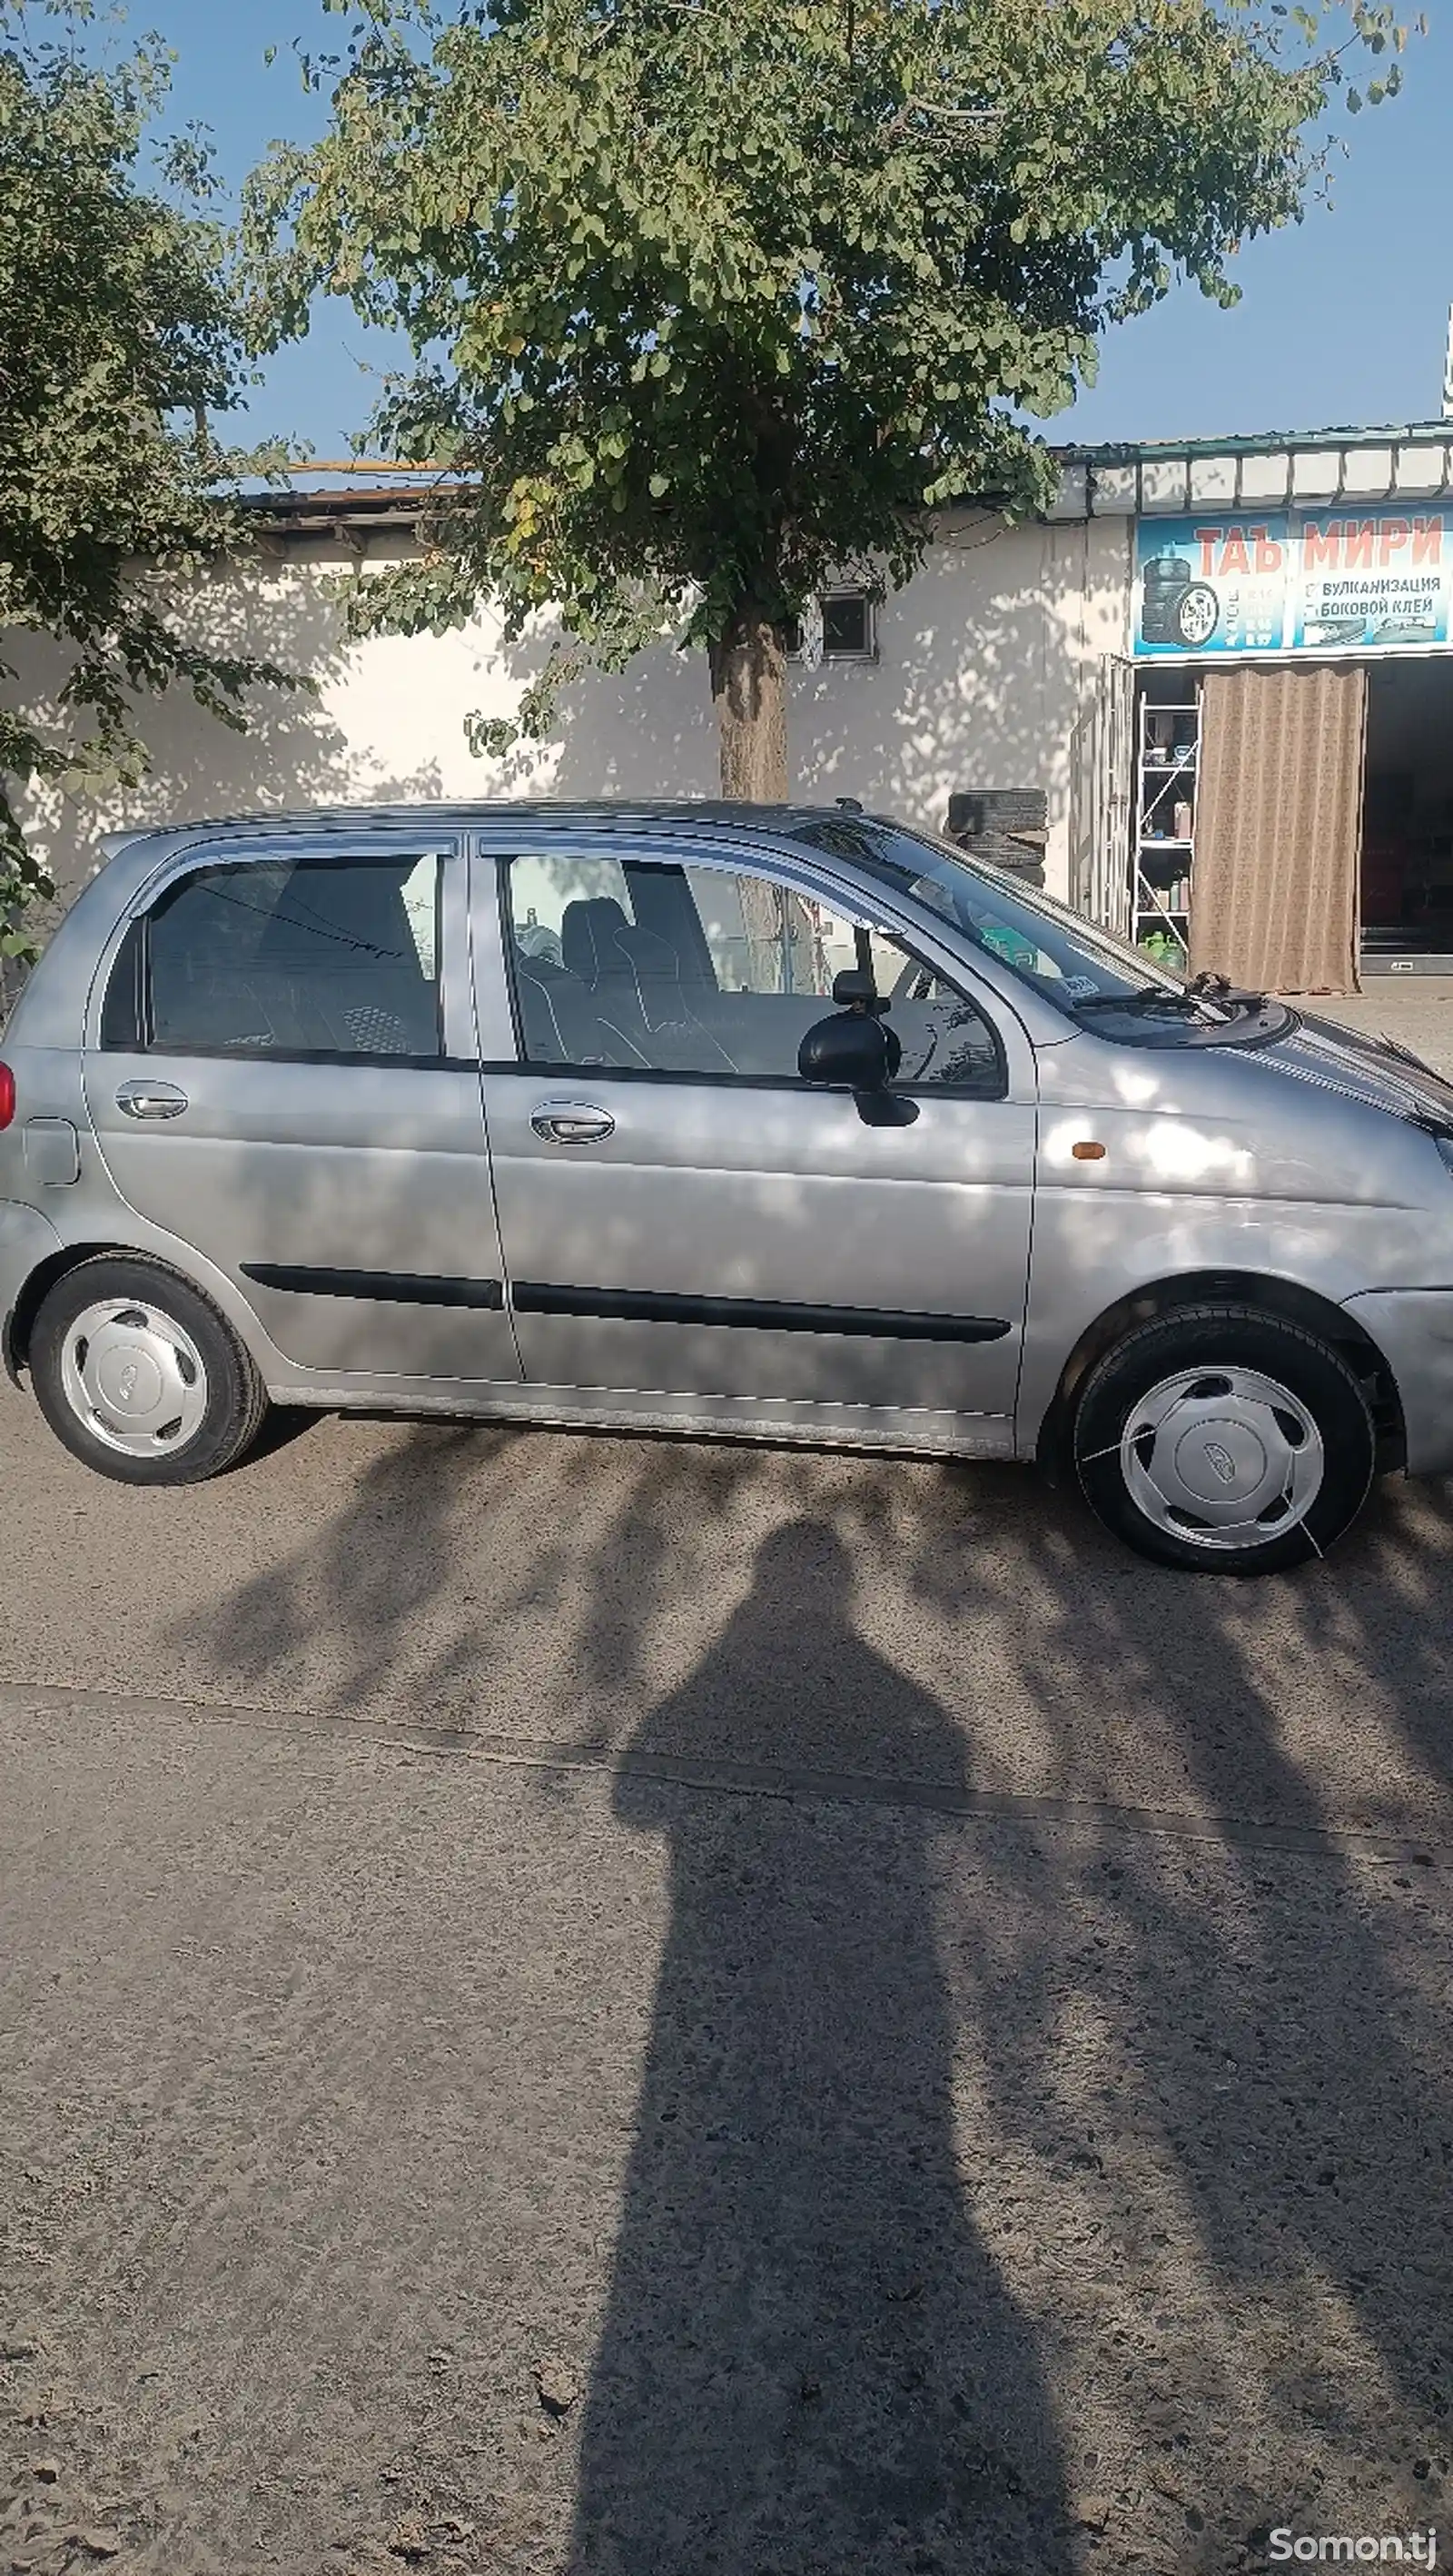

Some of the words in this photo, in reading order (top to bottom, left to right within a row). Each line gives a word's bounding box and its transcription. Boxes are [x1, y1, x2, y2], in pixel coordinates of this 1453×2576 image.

[1195, 523, 1282, 577] ТАЪ
[1302, 515, 1444, 571] МИРИ
[1322, 577, 1440, 597] ВУЛКАНИЗАЦИЯ
[1320, 597, 1389, 618] БОКОВОЙ
[1392, 595, 1433, 613] КЛЕЙ
